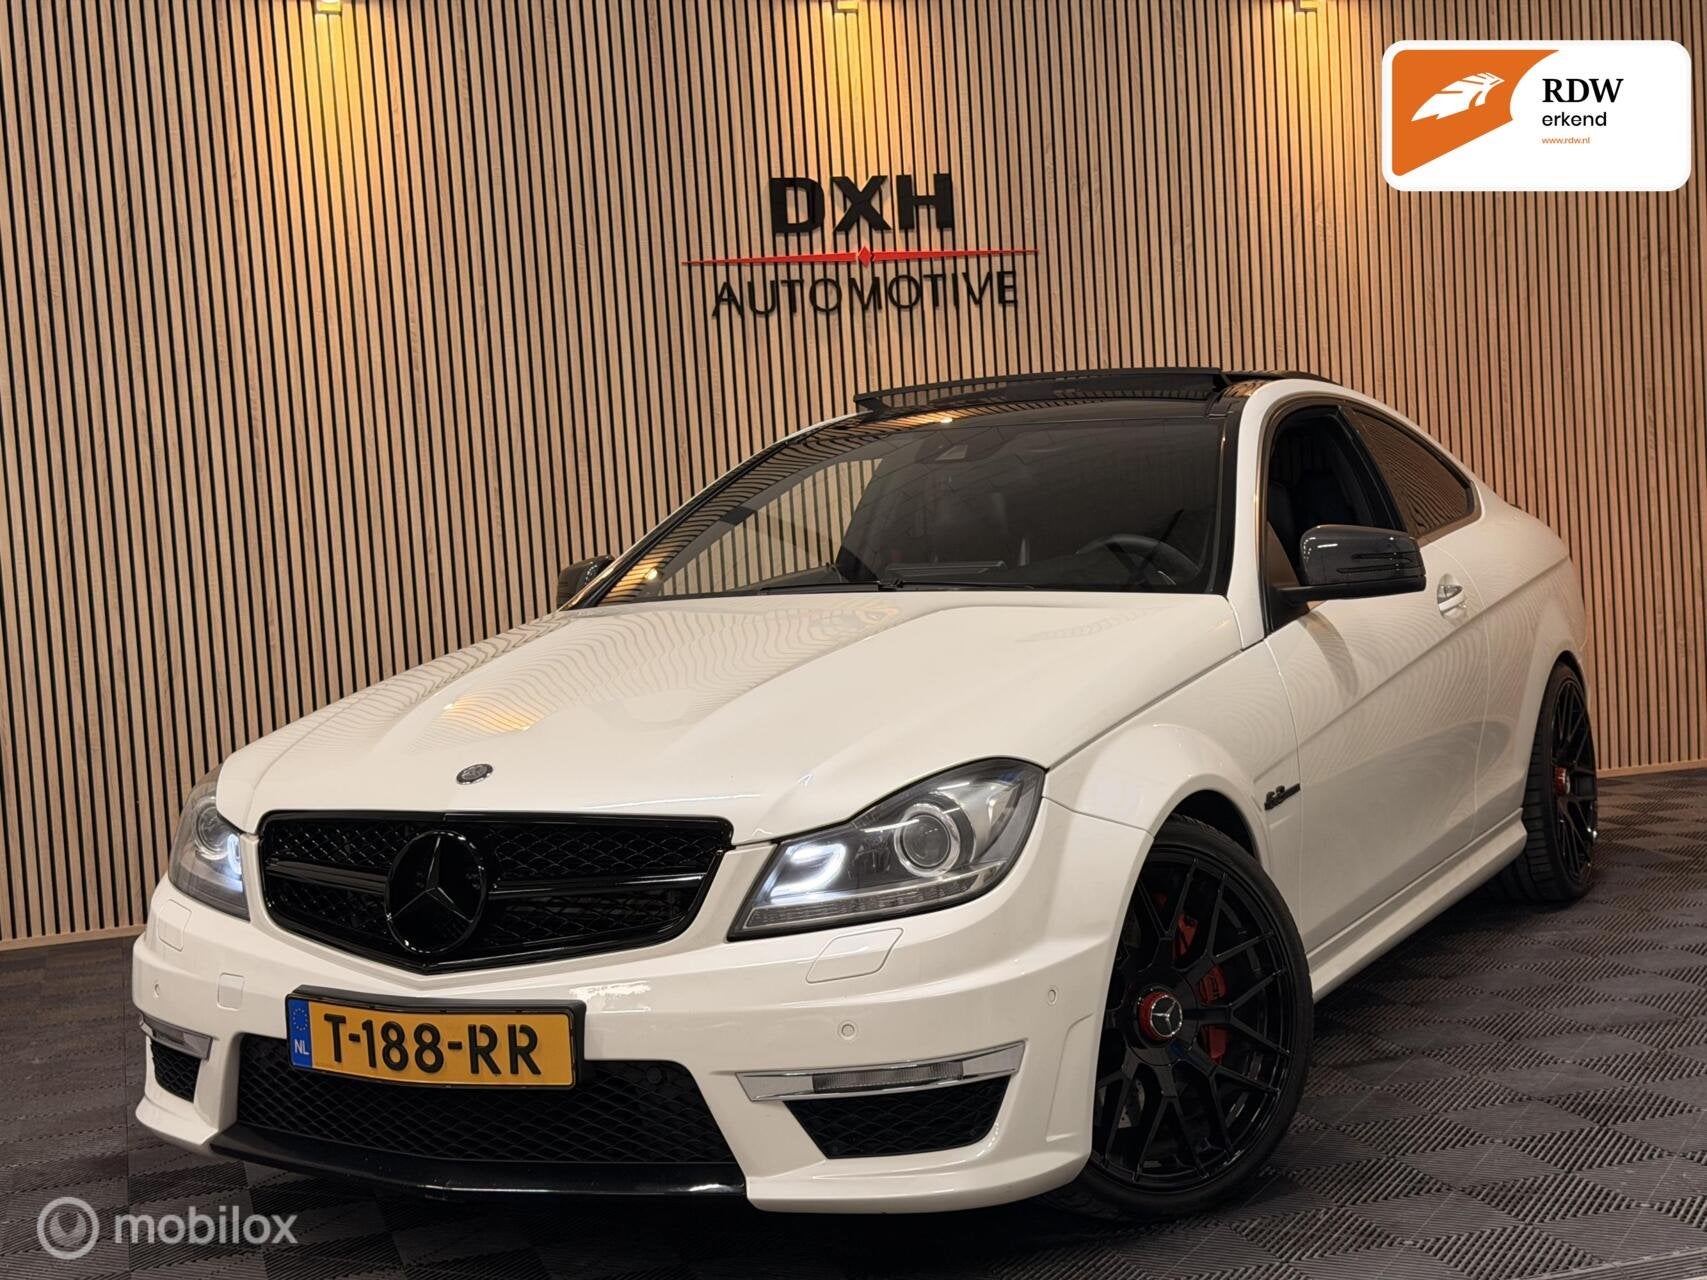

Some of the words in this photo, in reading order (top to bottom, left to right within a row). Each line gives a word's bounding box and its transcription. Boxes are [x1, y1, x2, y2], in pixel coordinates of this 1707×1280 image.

[769, 173, 954, 234] DXH
[711, 270, 1018, 318] AUTOMOTIVE
[294, 1039, 310, 1056] NL
[323, 1013, 542, 1075] T-188-RR
